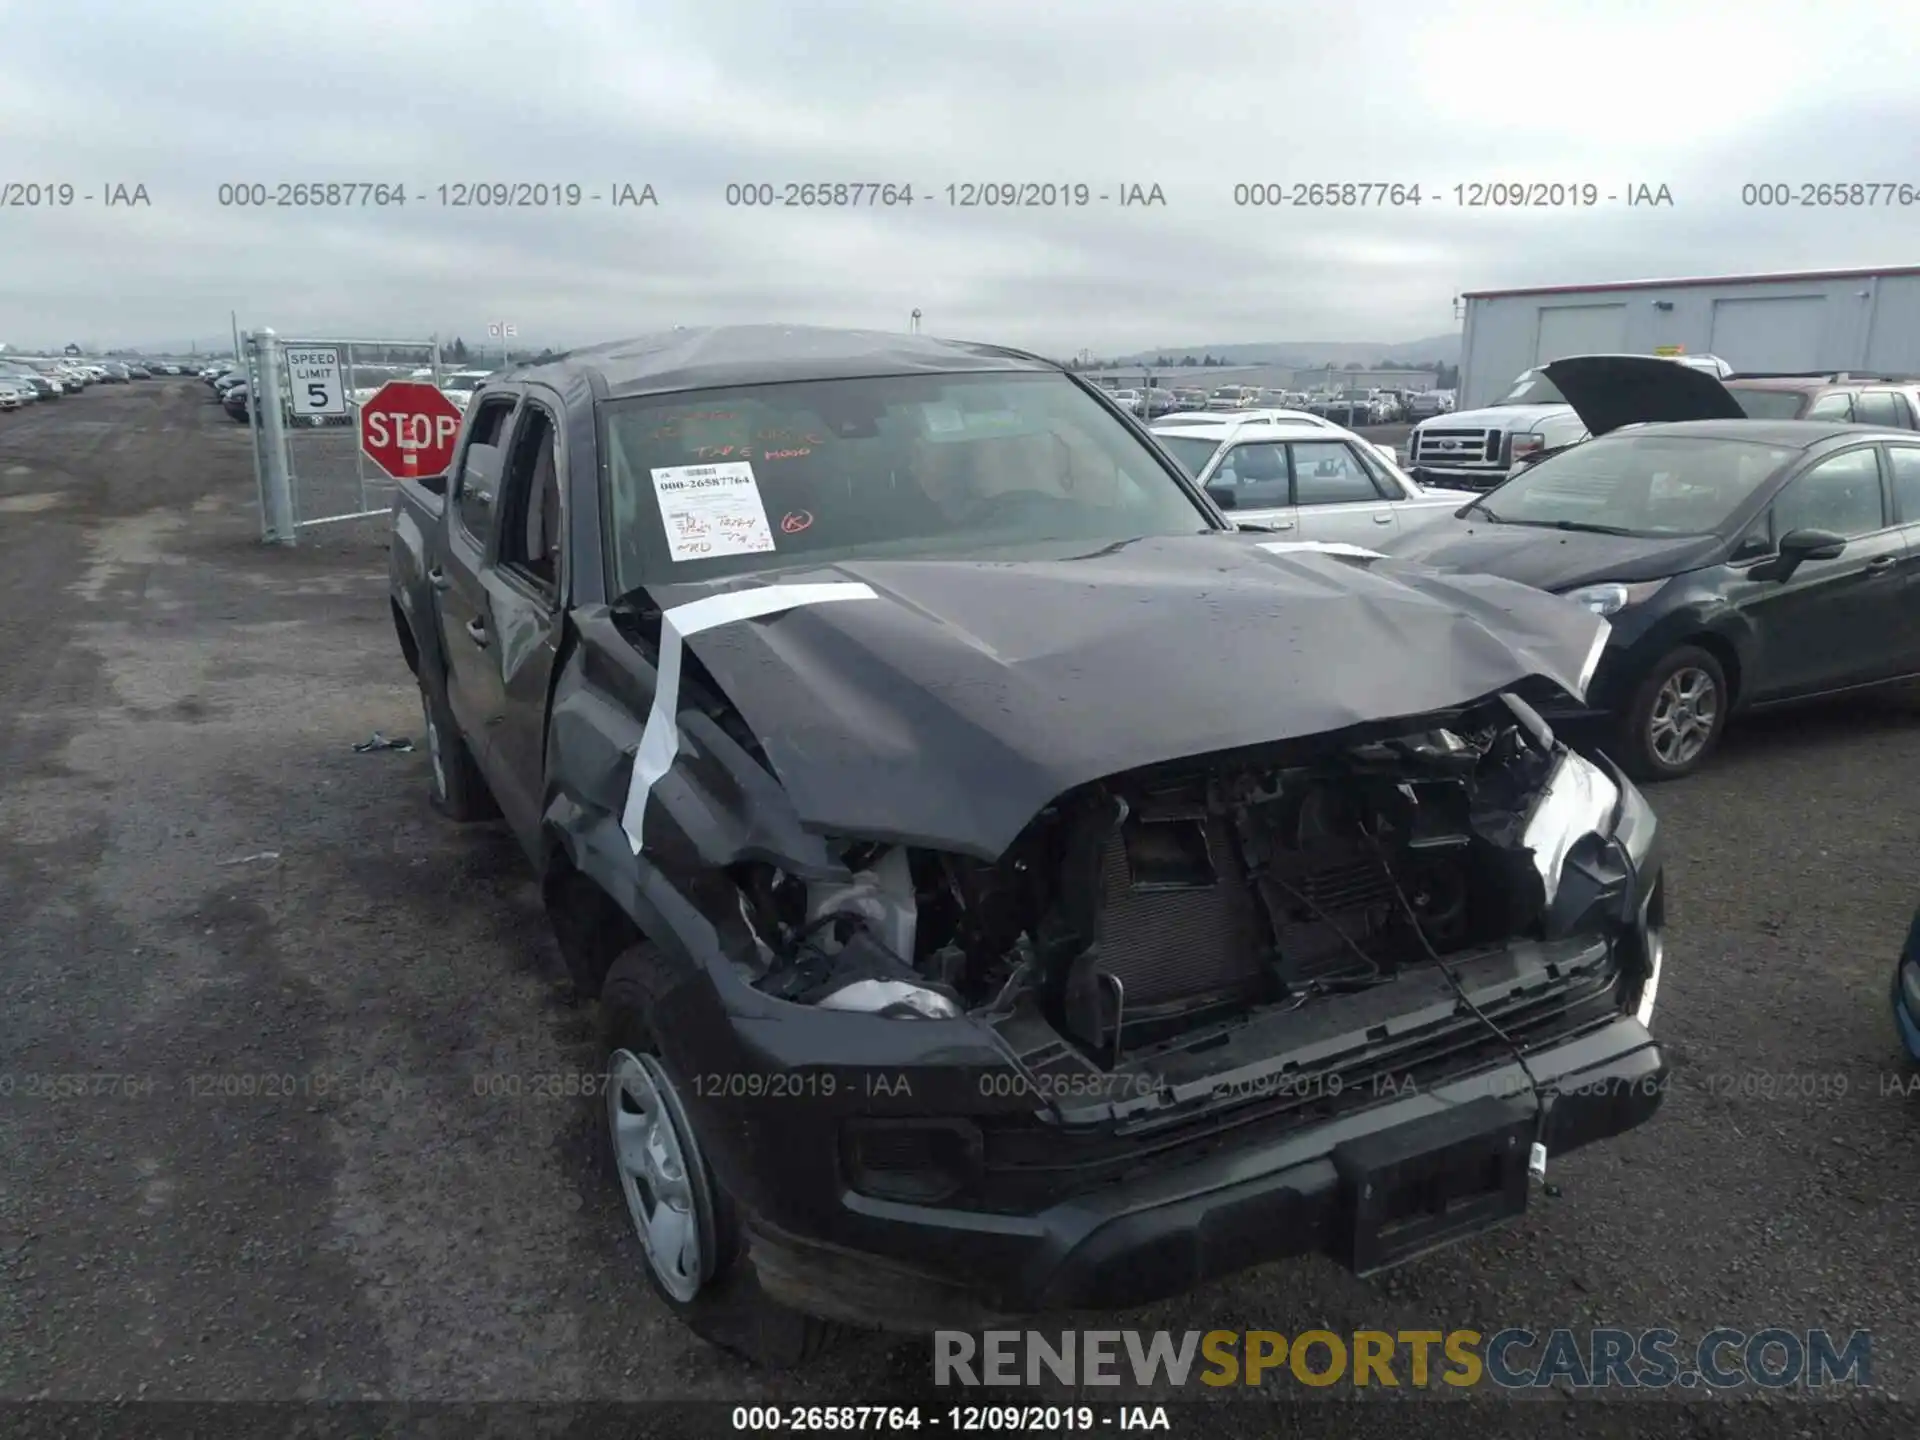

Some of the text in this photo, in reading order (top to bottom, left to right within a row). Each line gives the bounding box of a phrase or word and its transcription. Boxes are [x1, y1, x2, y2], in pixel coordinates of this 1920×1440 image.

[291, 353, 336, 365] SPEED
[297, 368, 332, 379] LIMIT
[307, 383, 329, 407] 5
[367, 411, 458, 450] STOP
[659, 475, 751, 491] 000-26587764
